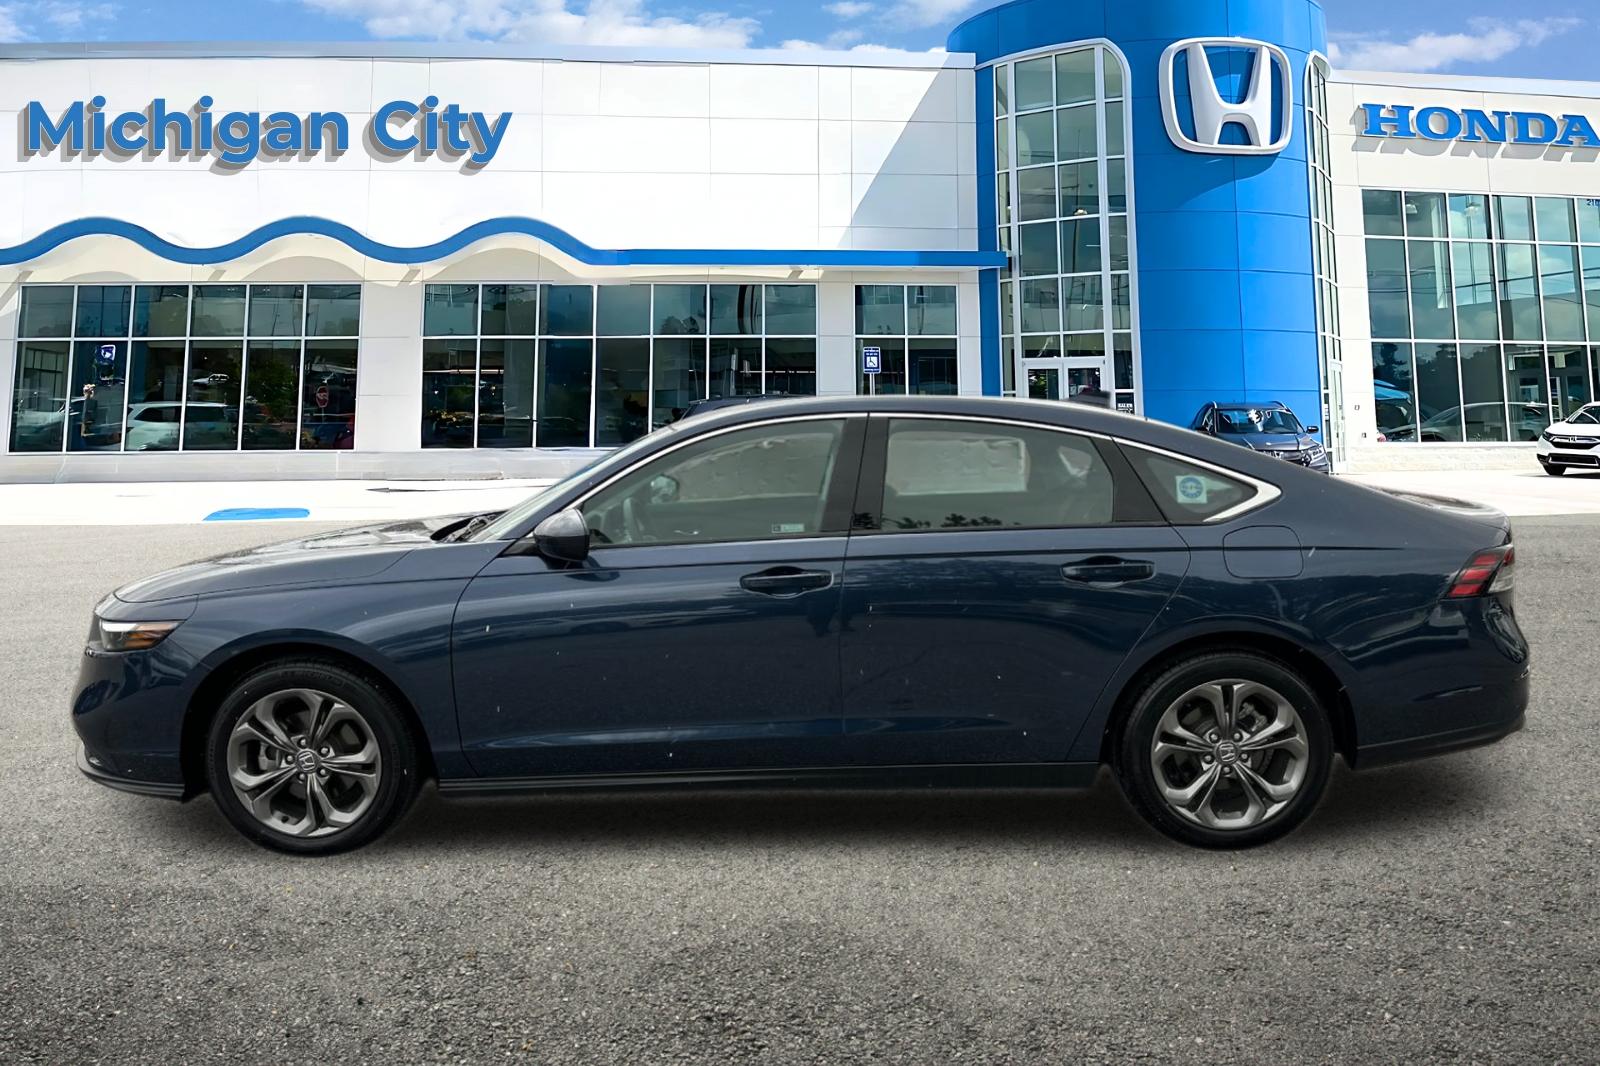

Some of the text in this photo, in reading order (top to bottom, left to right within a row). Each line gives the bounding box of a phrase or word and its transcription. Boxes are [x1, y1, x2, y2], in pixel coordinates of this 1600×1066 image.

[27, 95, 513, 164] Michigan City
[1361, 102, 1600, 148] HONDA
